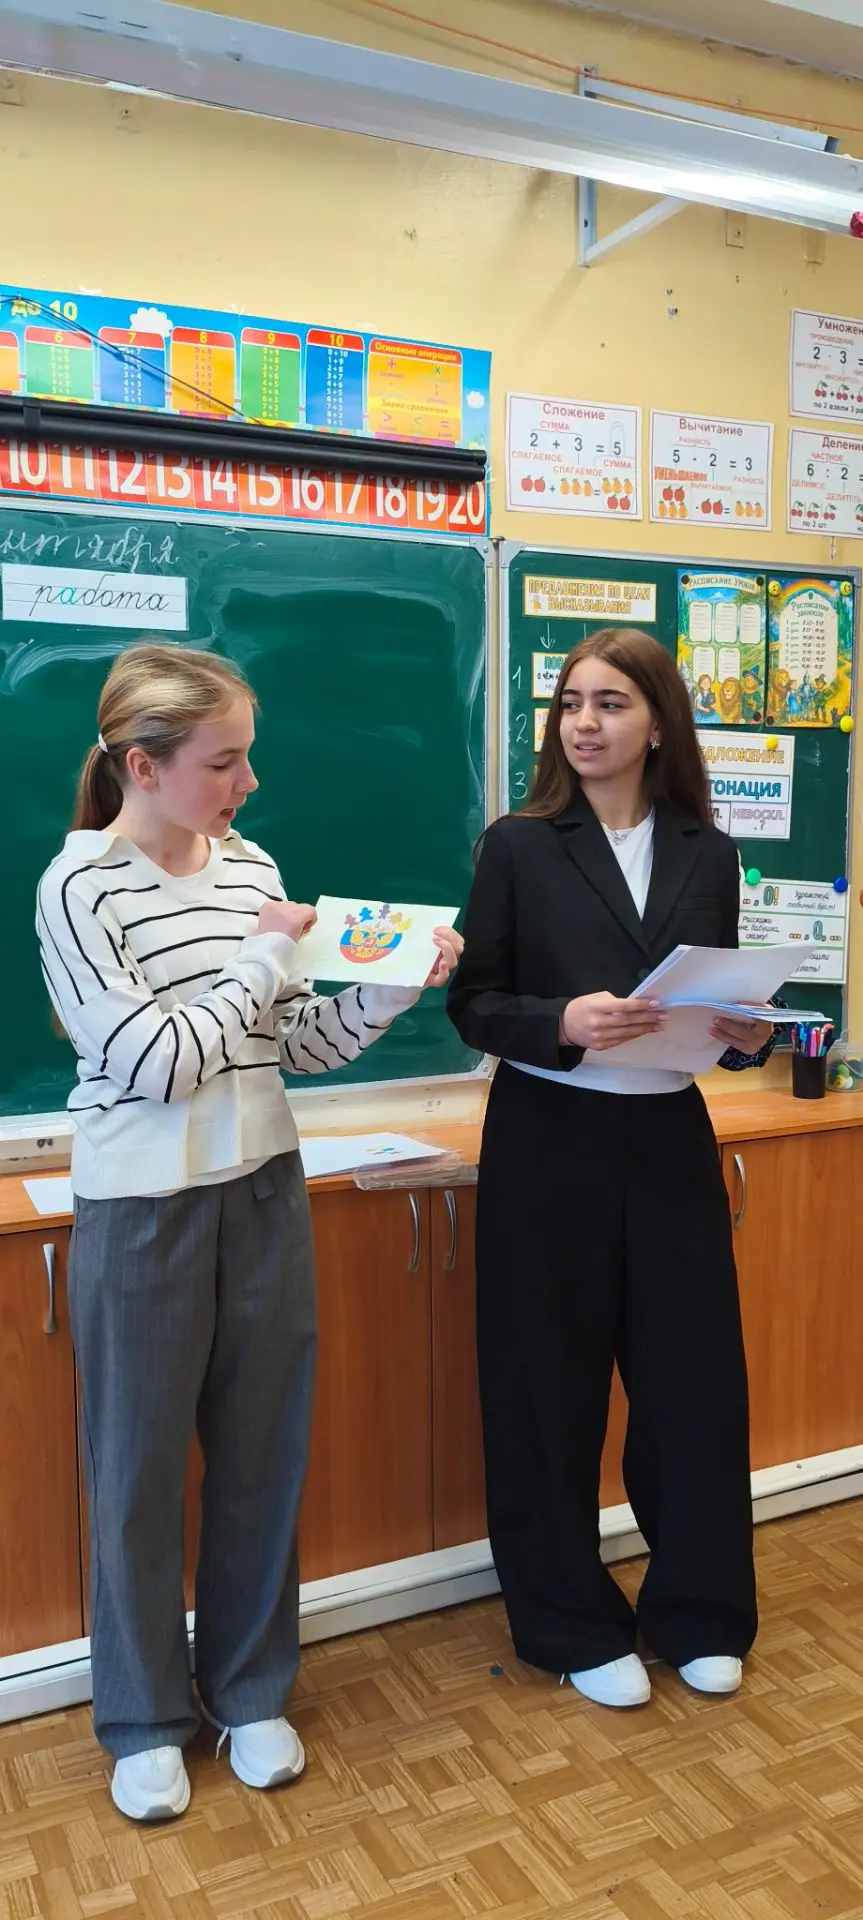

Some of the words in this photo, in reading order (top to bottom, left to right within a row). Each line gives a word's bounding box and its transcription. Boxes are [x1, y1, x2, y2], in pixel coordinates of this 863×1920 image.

[12, 299, 41, 317] до
[49, 299, 78, 321] 10
[54, 331, 64, 343] 6
[128, 332, 136, 343] 7
[199, 331, 208, 343] 8
[267, 333, 276, 344] 9
[329, 334, 344, 347] 10
[375, 342, 416, 355] Основные
[418, 350, 457, 361] операции
[813, 346, 820, 360] 2
[840, 351, 847, 364] 3
[543, 402, 606, 420] Сложение
[540, 420, 570, 431] СУММА
[679, 418, 743, 436] Вычитание
[530, 433, 538, 447] 2
[574, 437, 583, 451] 3
[613, 442, 621, 455] 5
[512, 450, 563, 463] СЛАГАЕМОЕ
[603, 460, 632, 469] СУММА
[673, 450, 680, 463] 5
[710, 453, 717, 467] 2
[745, 457, 753, 471] 3
[811, 451, 844, 462] ЧАСТНОЕ
[553, 466, 603, 477] СЛАГАЕМОЕ
[807, 463, 814, 476] 6
[841, 467, 848, 480] 2
[2, 438, 48, 486] 10
[53, 443, 95, 490] 11
[101, 447, 147, 496] 12
[149, 451, 191, 499] 13
[195, 456, 237, 504] 14
[241, 461, 281, 507] 15
[285, 465, 325, 512] 16
[328, 470, 364, 514] 17
[370, 475, 406, 518] 18
[410, 478, 446, 522] 19
[449, 480, 485, 526] 20
[29, 574, 169, 616] работа
[528, 580, 604, 597] ПРЕДЛОЖЕНИЯ
[608, 585, 620, 598] ПО
[624, 587, 650, 600] ЦЕЛИ
[548, 596, 632, 614] ВЫСКАЗЫВАНИЯ
[512, 665, 522, 690] 1
[515, 713, 529, 744] 2
[512, 771, 529, 800] 3
